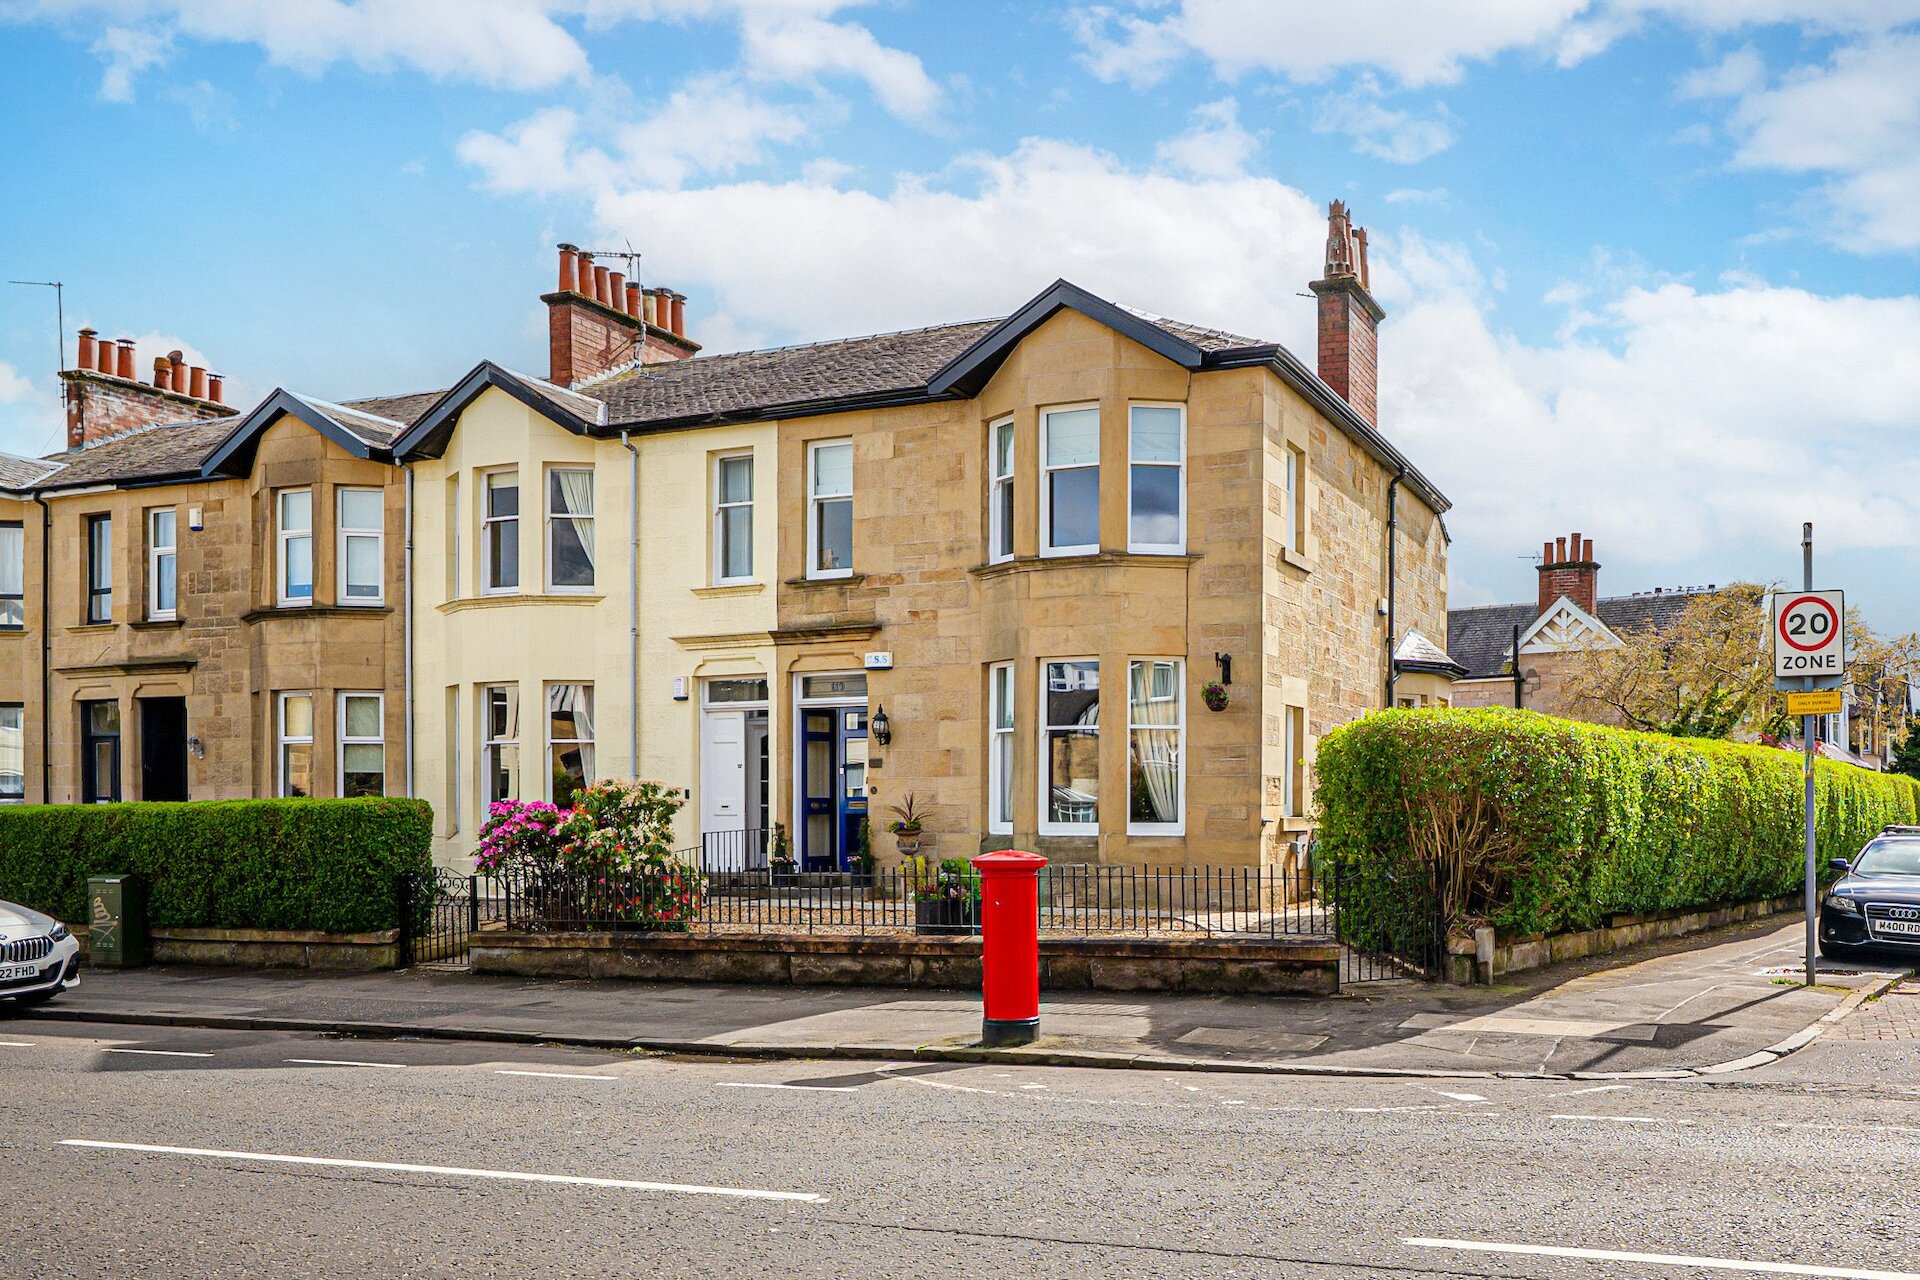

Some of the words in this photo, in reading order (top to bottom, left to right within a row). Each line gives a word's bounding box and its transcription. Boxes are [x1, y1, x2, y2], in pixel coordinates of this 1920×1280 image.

[1789, 613, 1828, 635] 20
[1783, 655, 1836, 669] ZONE
[15, 966, 35, 977] FHD
